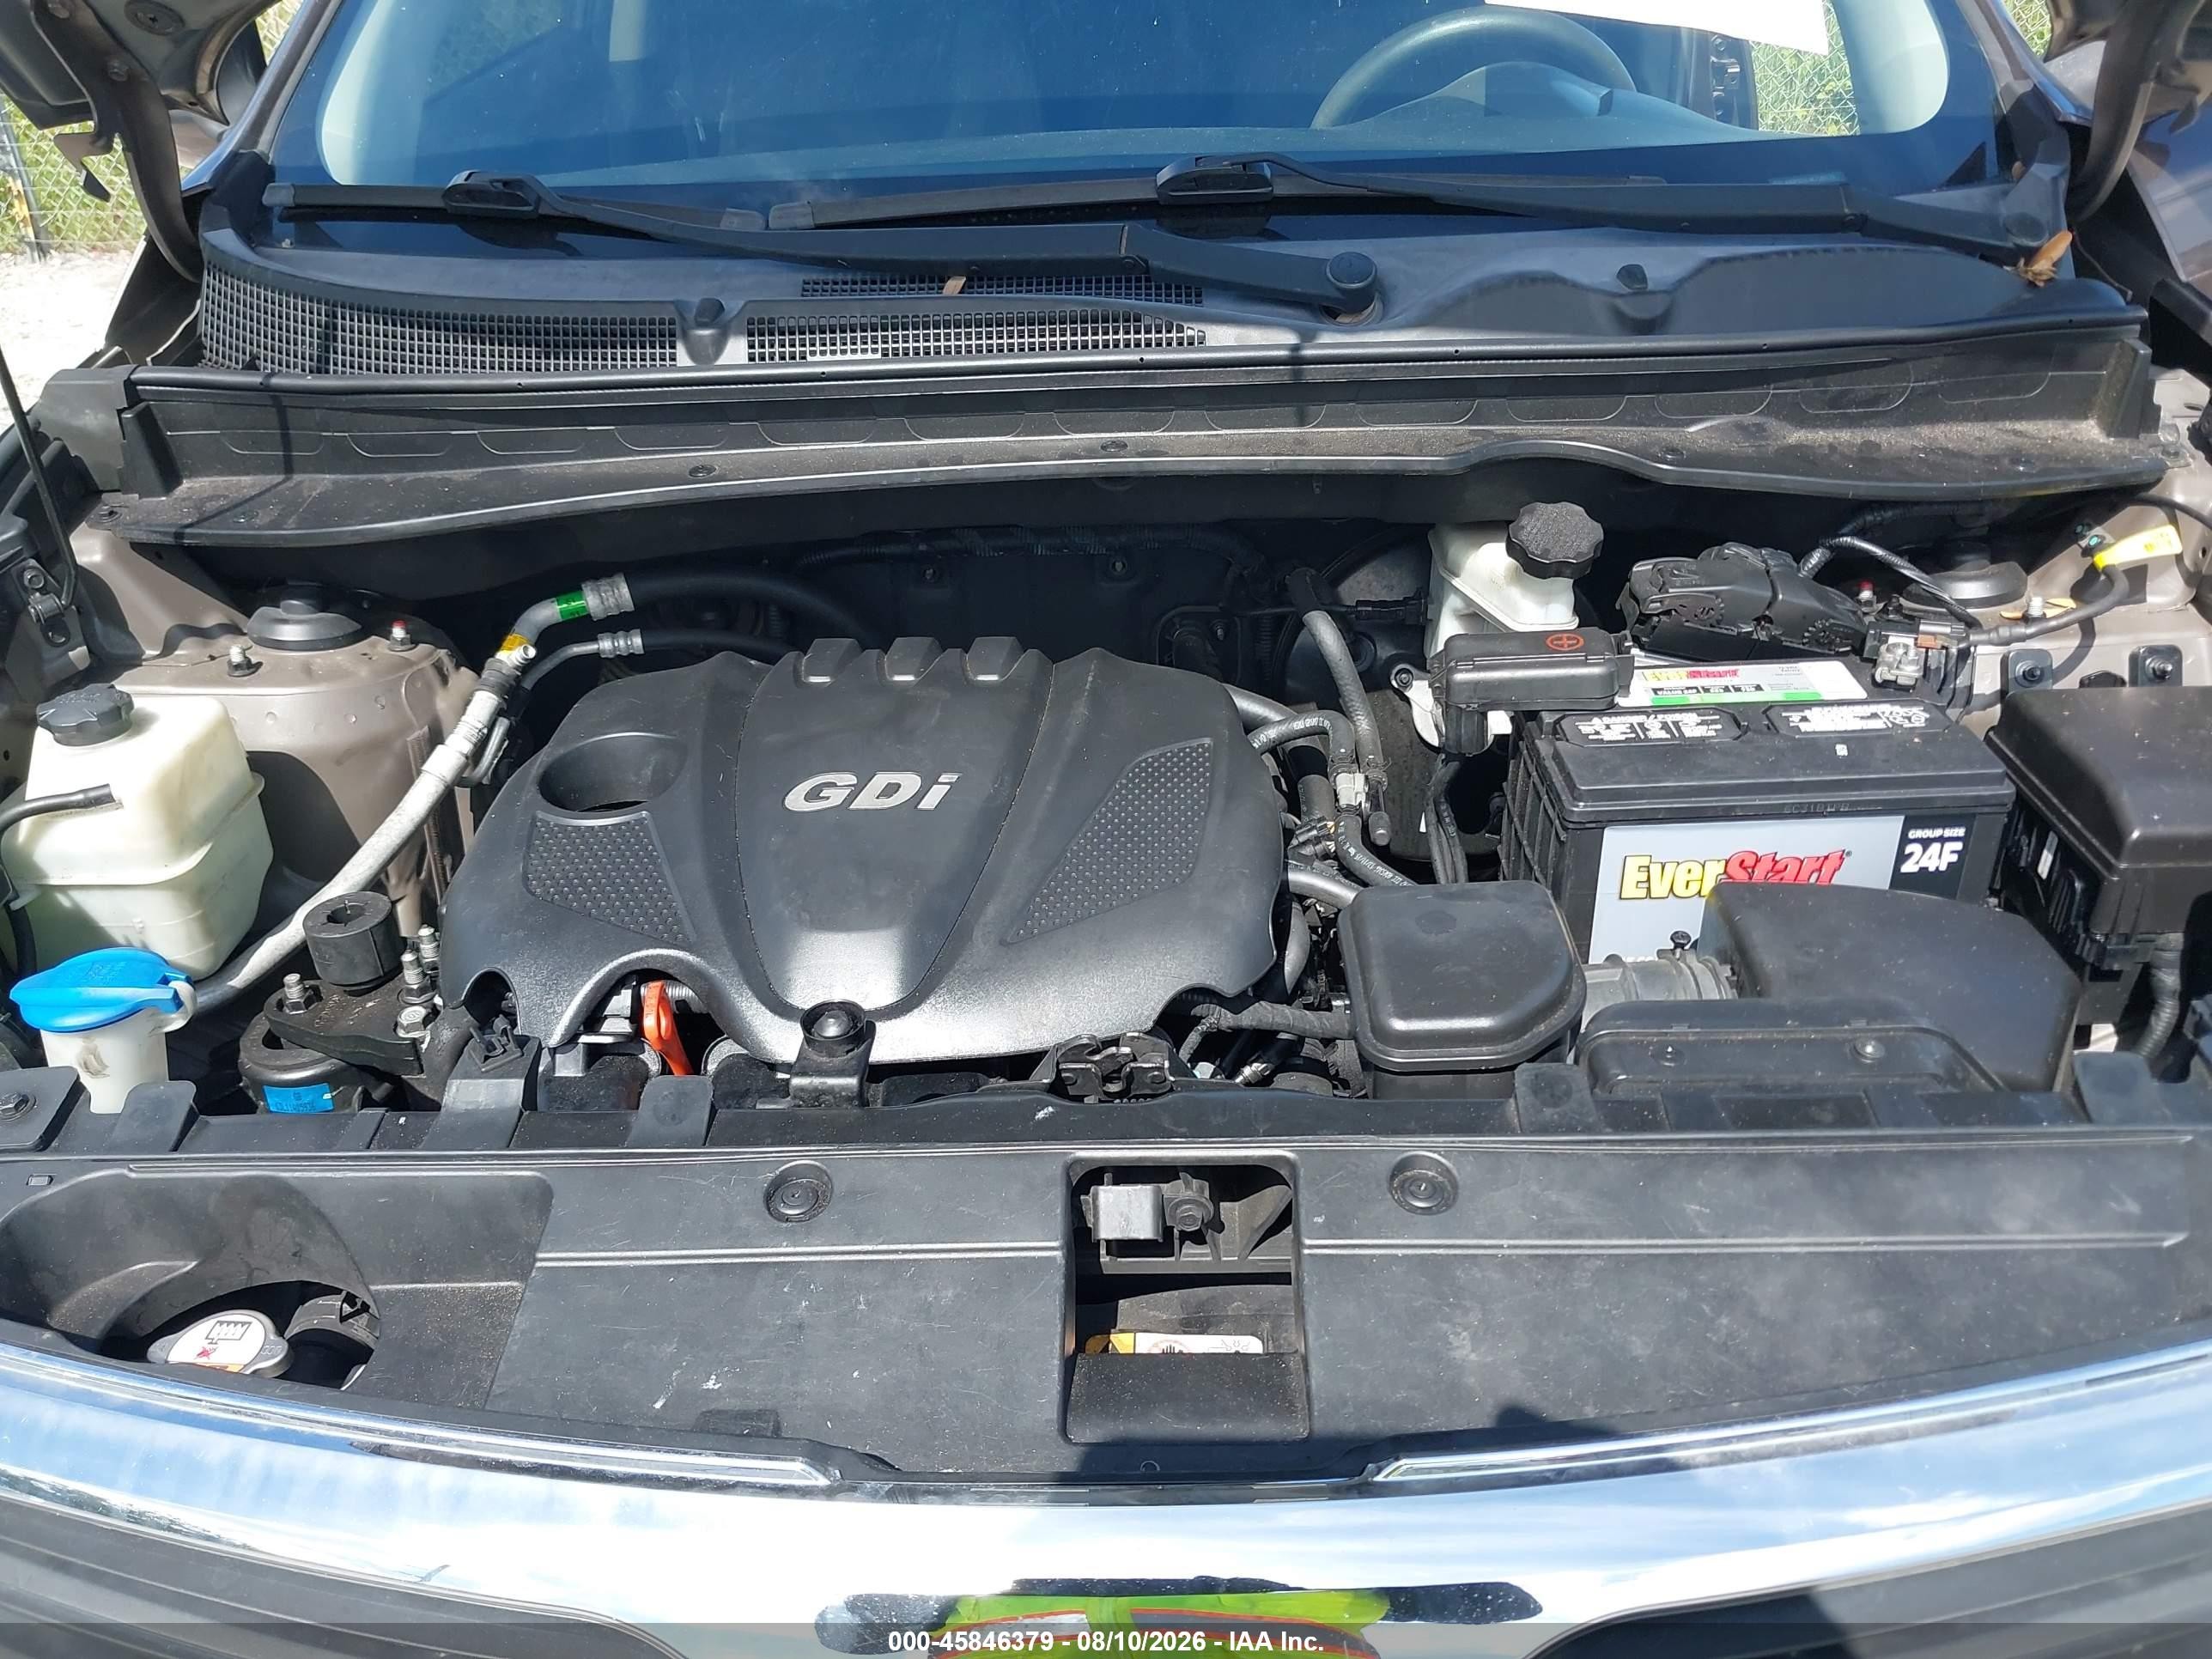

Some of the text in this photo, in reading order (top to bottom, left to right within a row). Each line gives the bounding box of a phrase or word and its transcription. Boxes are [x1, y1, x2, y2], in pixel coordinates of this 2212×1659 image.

[783, 771, 963, 812] GDi
[1908, 826, 1966, 839] GROUP SIZE
[1619, 848, 1846, 900] EverStart
[1899, 841, 1964, 873] 24F
